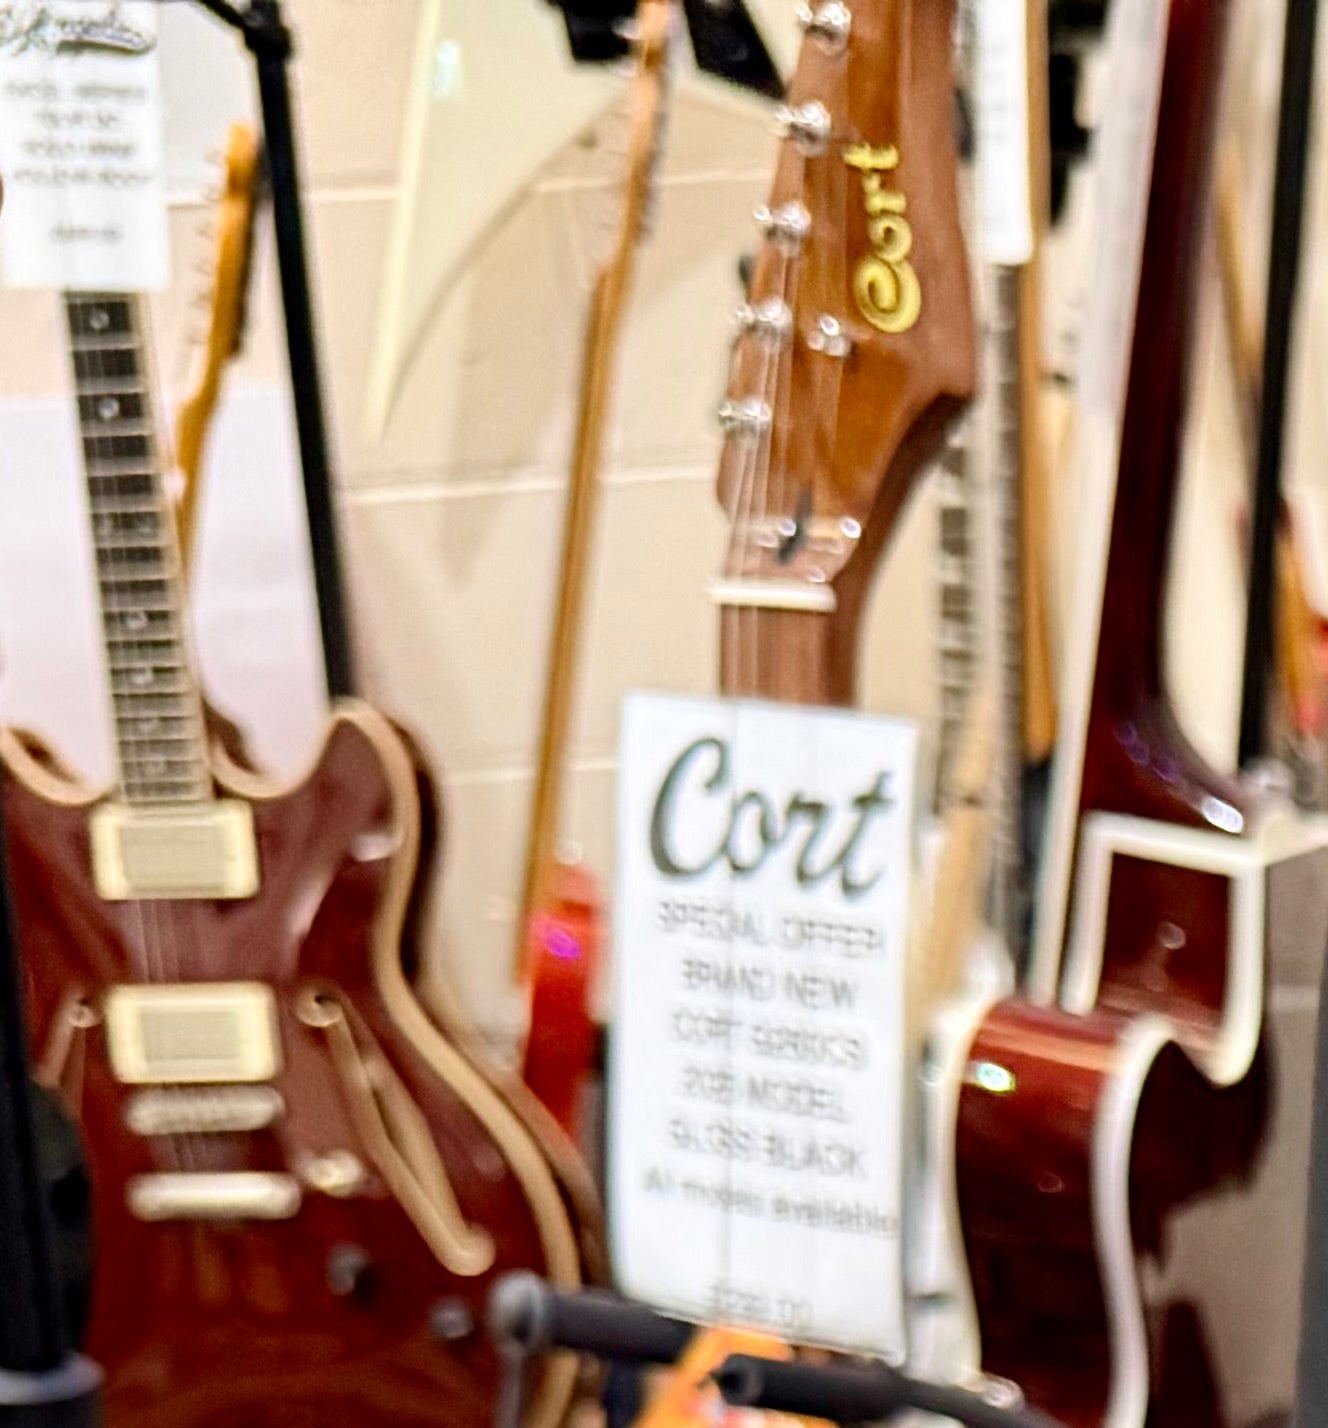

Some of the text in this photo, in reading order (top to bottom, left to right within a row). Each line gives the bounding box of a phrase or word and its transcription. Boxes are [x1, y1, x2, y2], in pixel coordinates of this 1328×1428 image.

[842, 143, 922, 333] Cort
[649, 736, 896, 898] Cort
[785, 969, 857, 1009] NEW
[765, 1133, 866, 1179] BLACK
